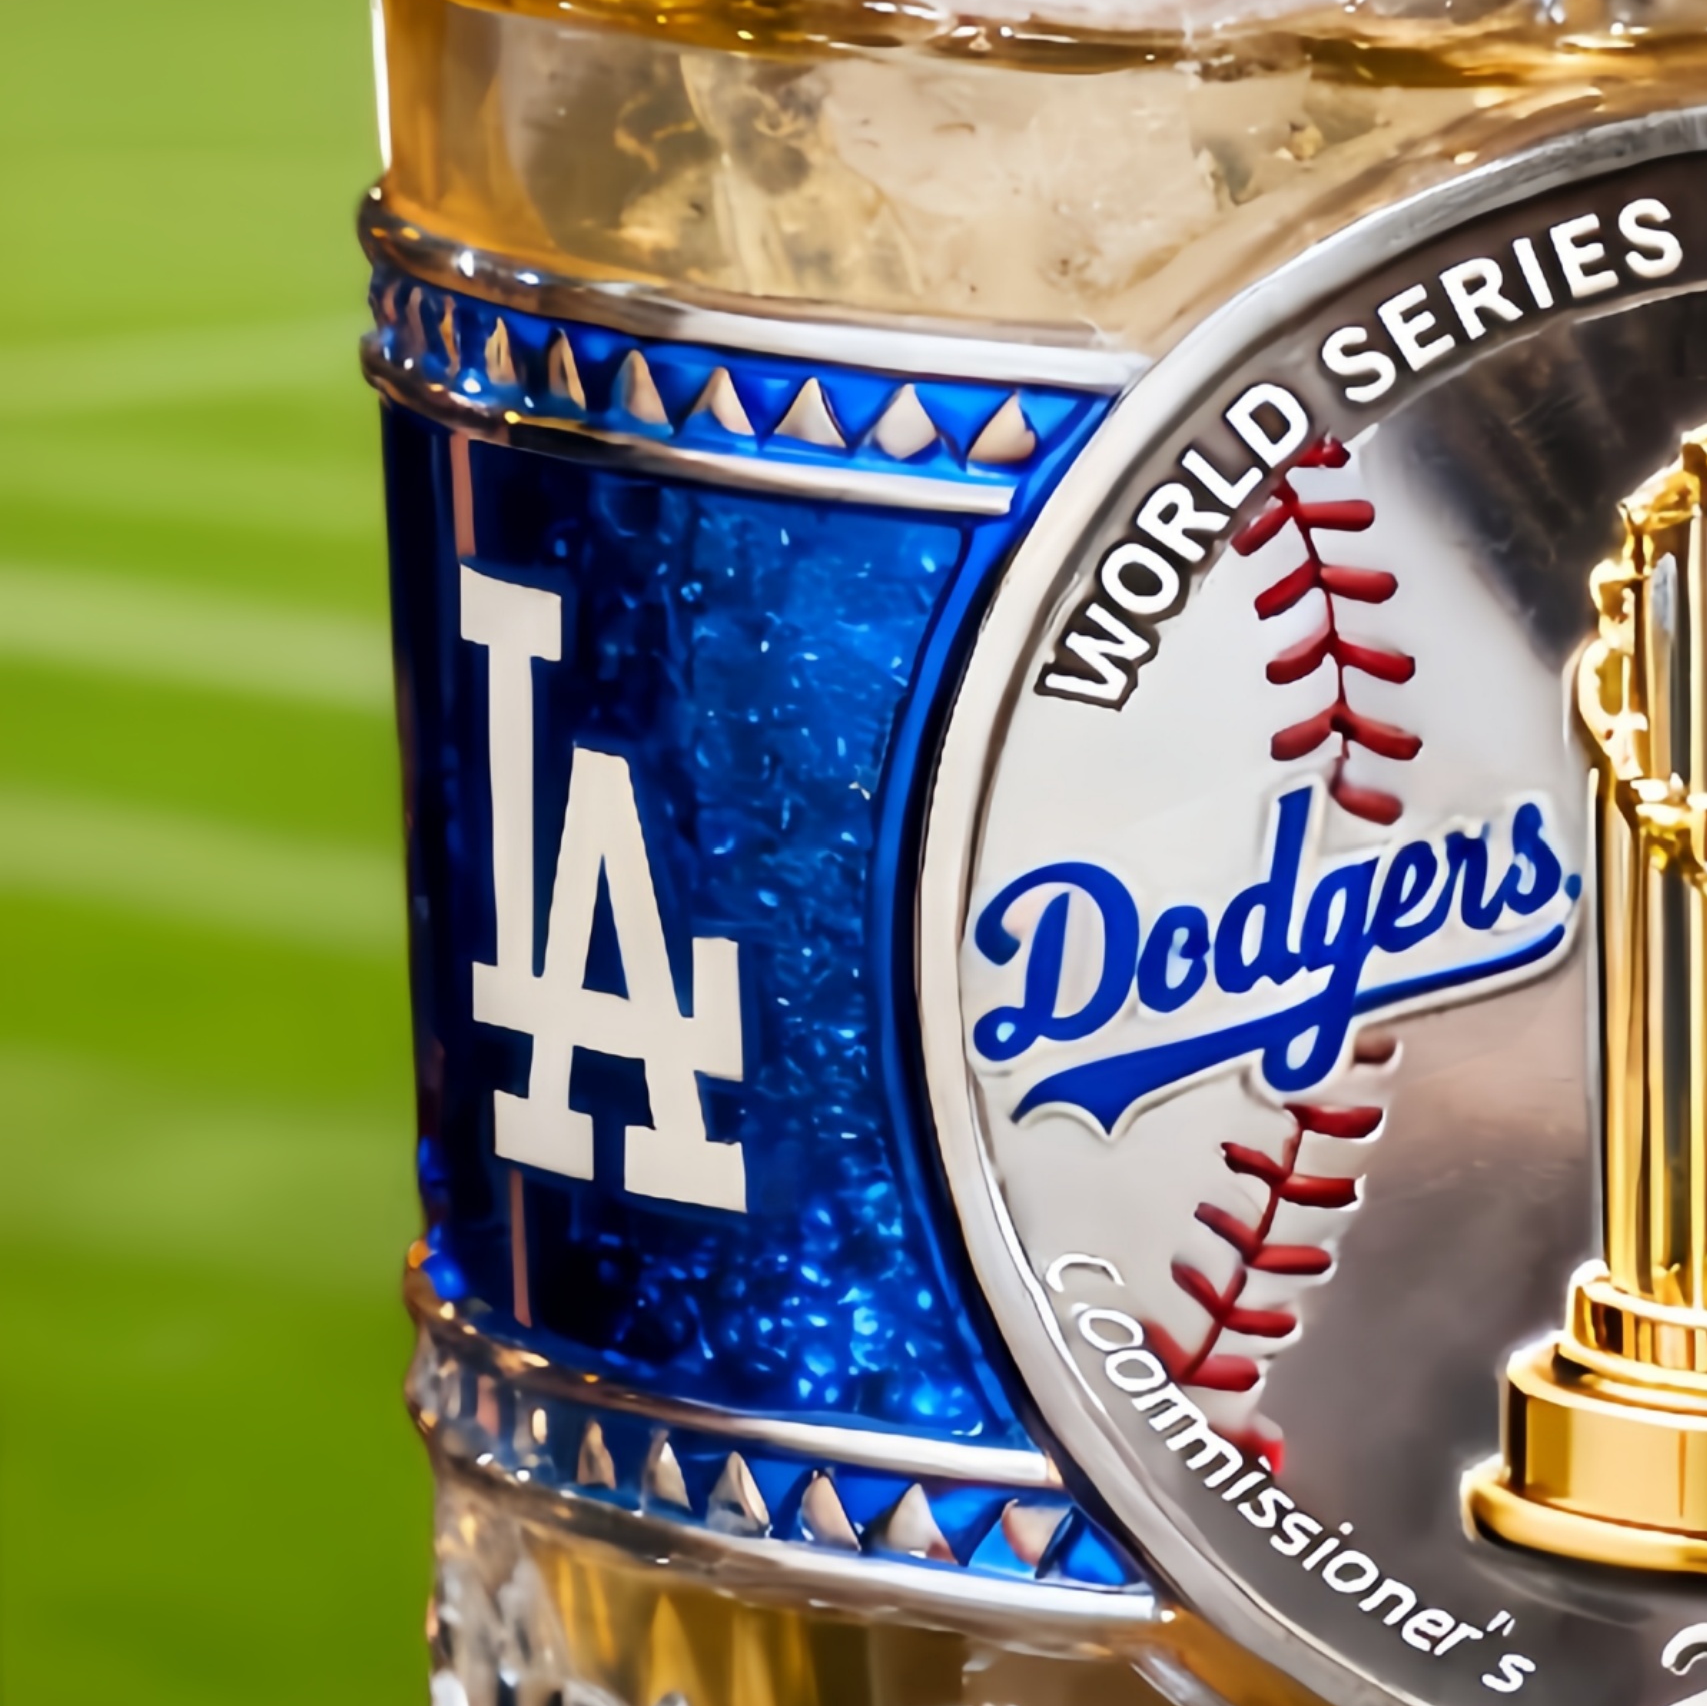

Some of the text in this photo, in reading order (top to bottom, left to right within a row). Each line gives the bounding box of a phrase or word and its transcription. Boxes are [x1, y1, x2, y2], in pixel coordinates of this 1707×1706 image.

[1043, 381, 1311, 704] WORLD
[1320, 196, 1685, 404] SERIES
[459, 563, 749, 1214] LA
